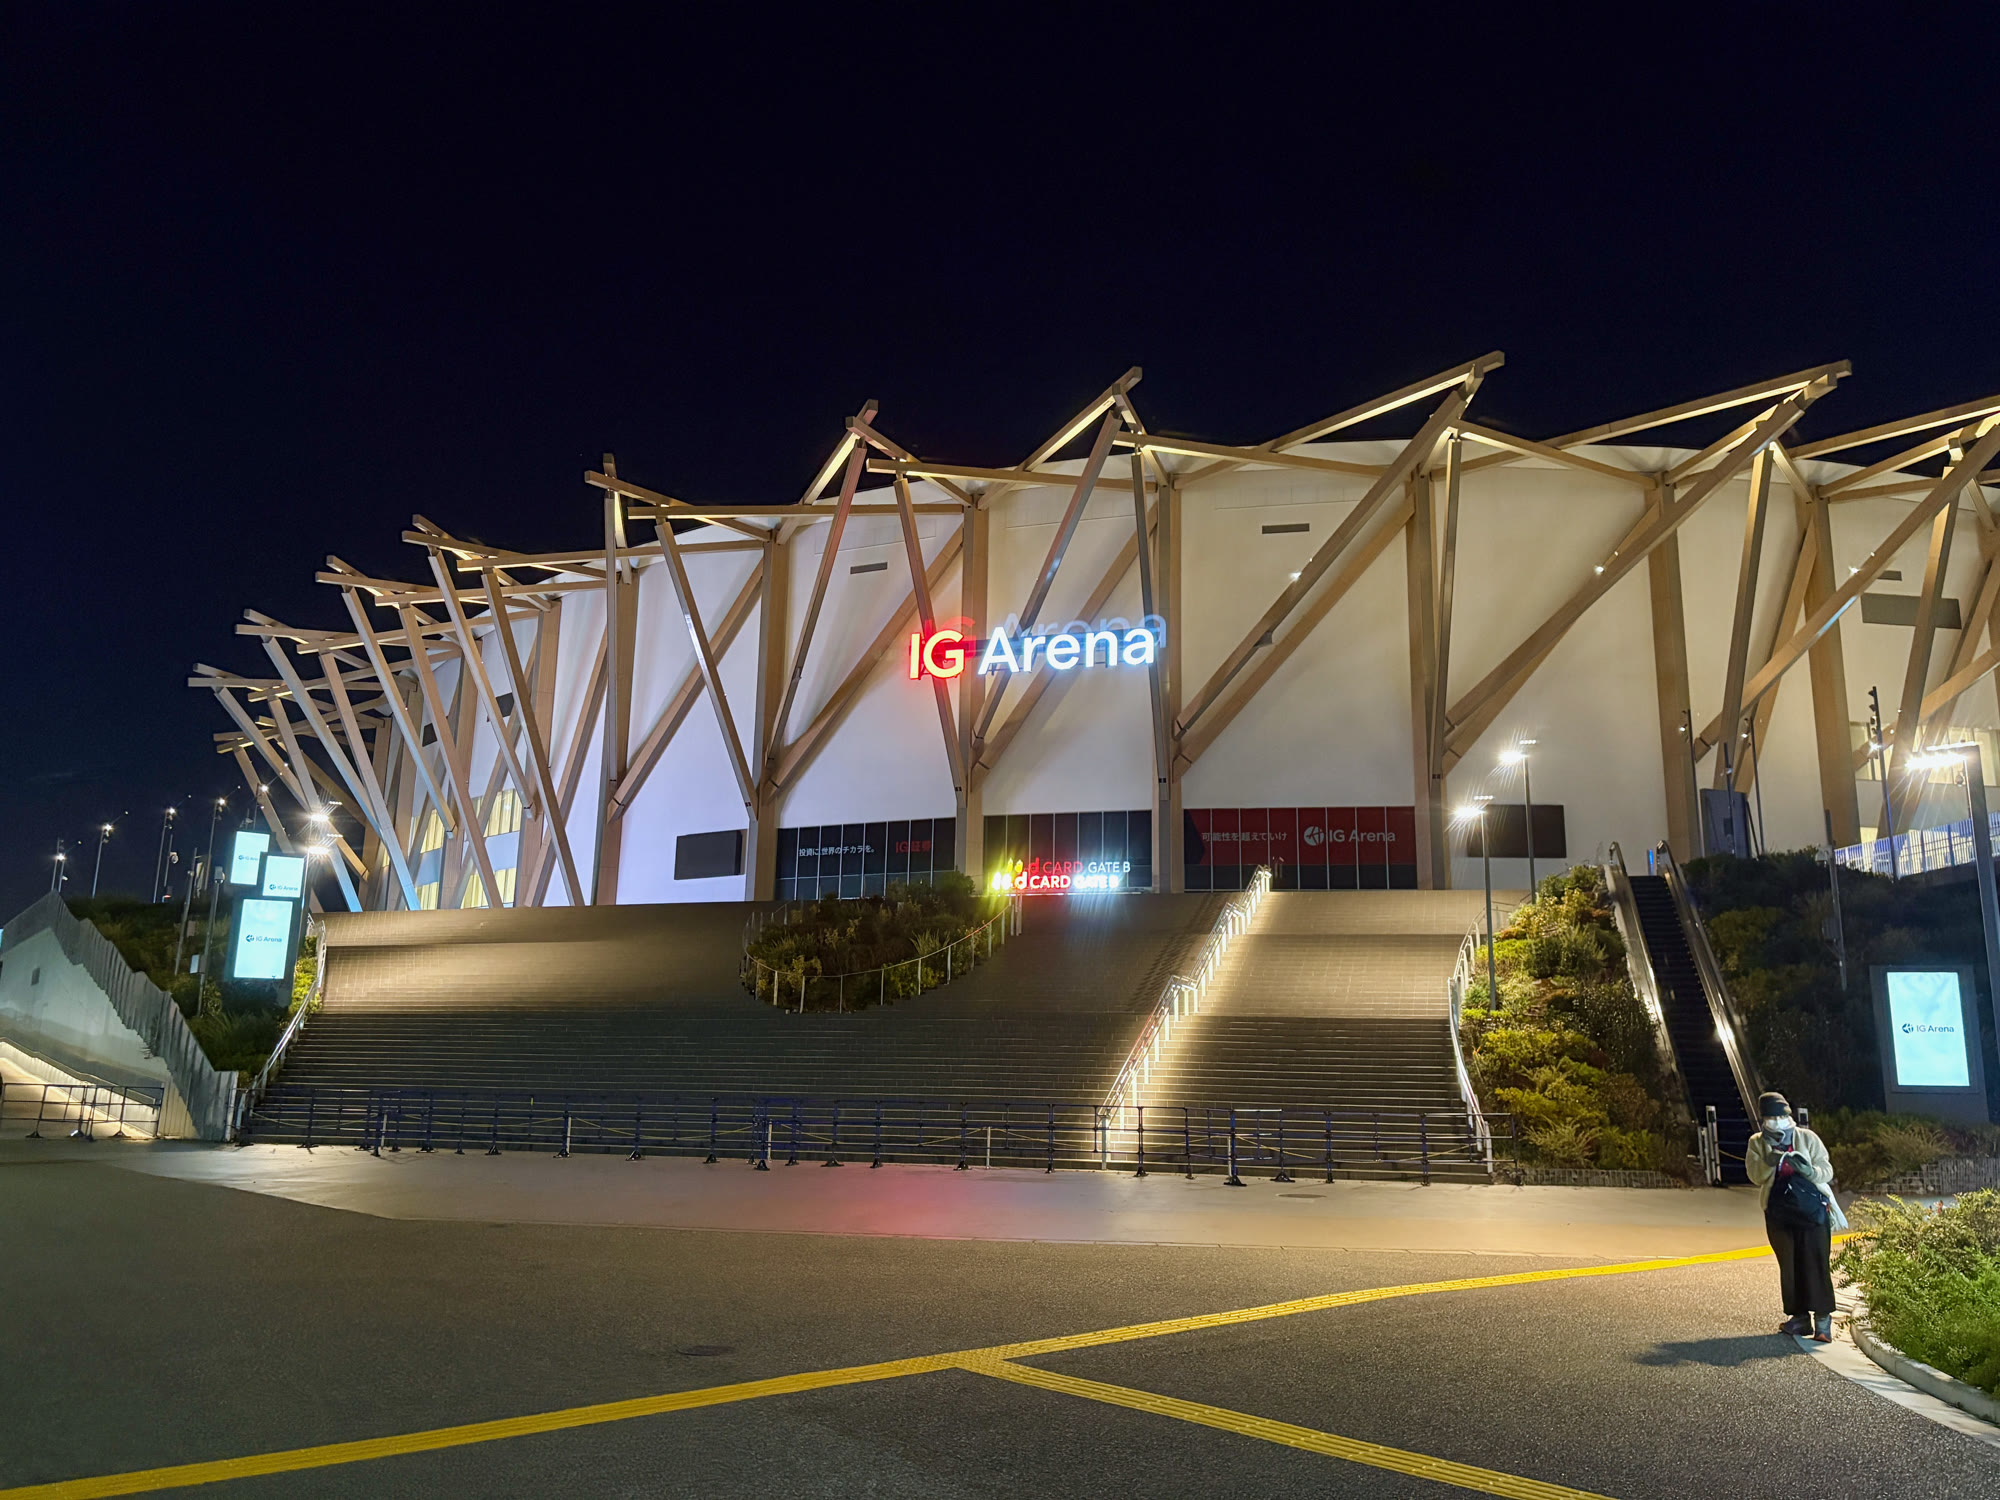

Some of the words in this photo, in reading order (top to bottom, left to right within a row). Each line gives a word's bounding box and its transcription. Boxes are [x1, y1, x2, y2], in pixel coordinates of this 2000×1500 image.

[909, 630, 965, 679] IG
[978, 626, 1155, 675] Arena
[1202, 832, 1287, 841] 可能性を超えていけ
[1329, 829, 1345, 843] IG
[1349, 829, 1396, 843] Arena
[799, 845, 874, 857] 投資に世界のチカラを。
[1042, 861, 1084, 874] CARD
[1087, 861, 1119, 873] GATE
[1122, 861, 1131, 873] B
[1029, 875, 1071, 889] CARD
